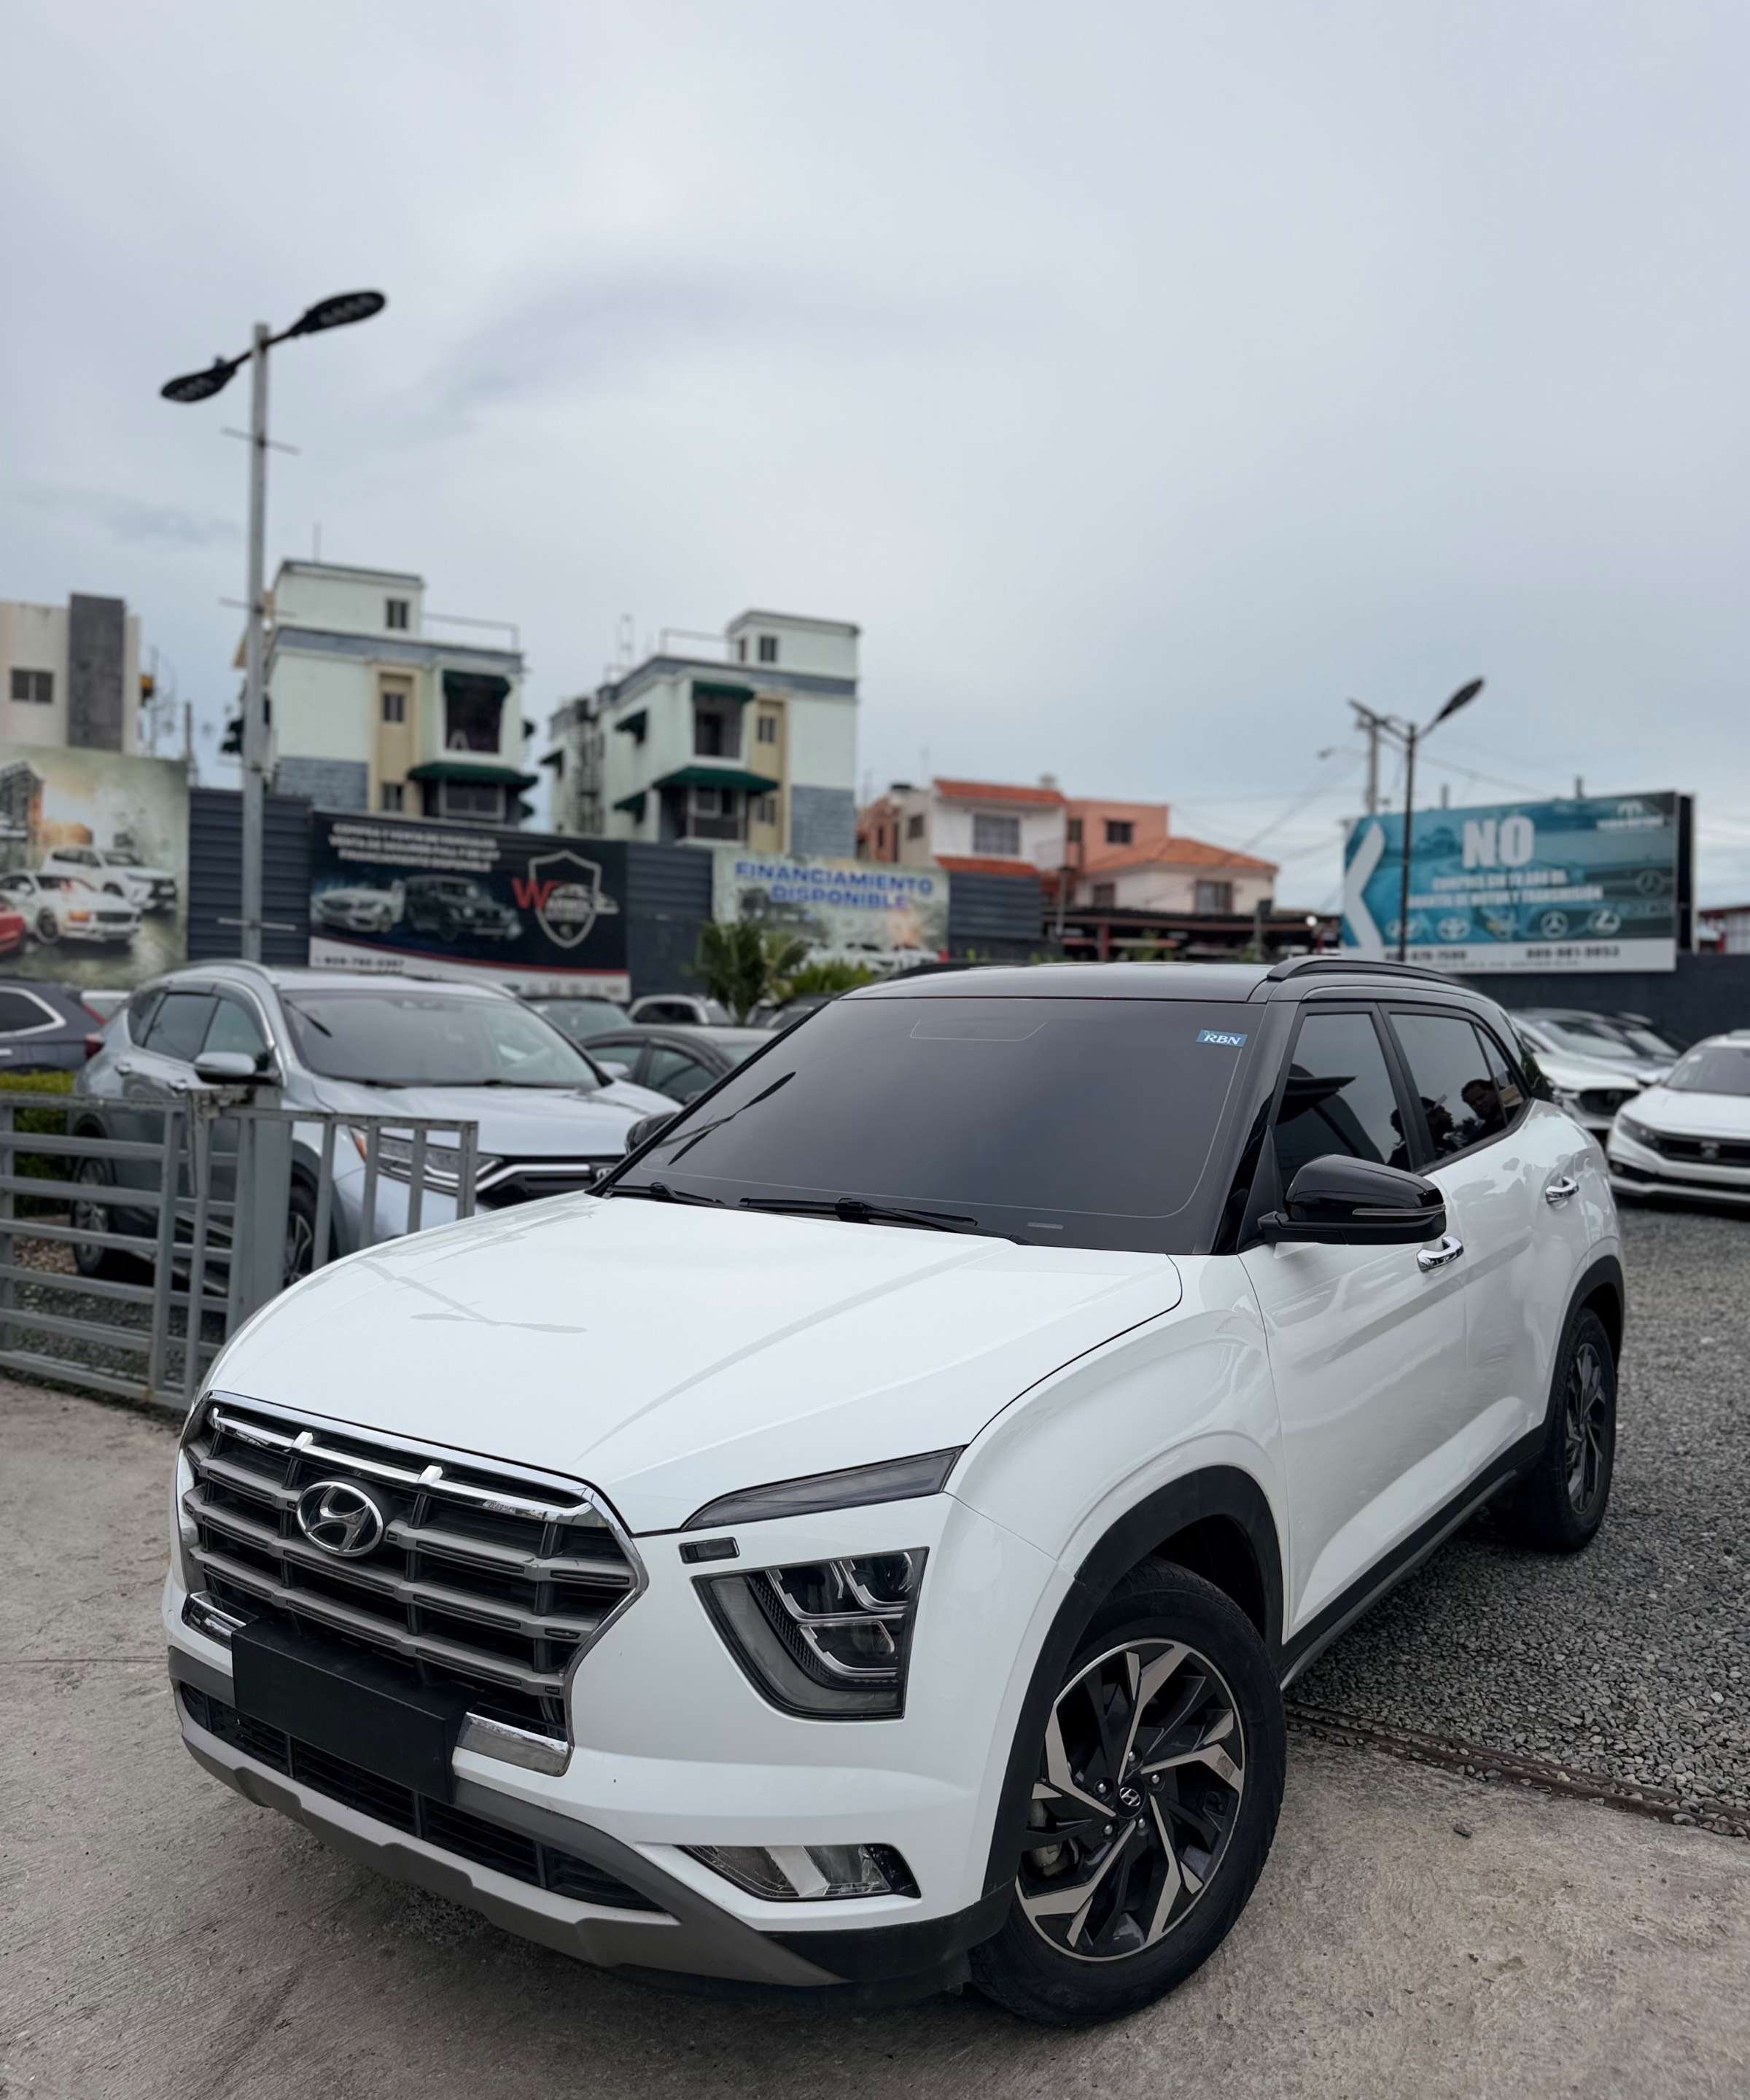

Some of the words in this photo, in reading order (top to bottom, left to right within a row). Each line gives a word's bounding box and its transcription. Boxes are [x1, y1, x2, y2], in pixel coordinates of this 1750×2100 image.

[1463, 815, 1535, 868] NO
[735, 860, 934, 896] FINANCIAMIENTO
[769, 885, 909, 908] DISPONIBLE
[1204, 1034, 1241, 1045] RBN
